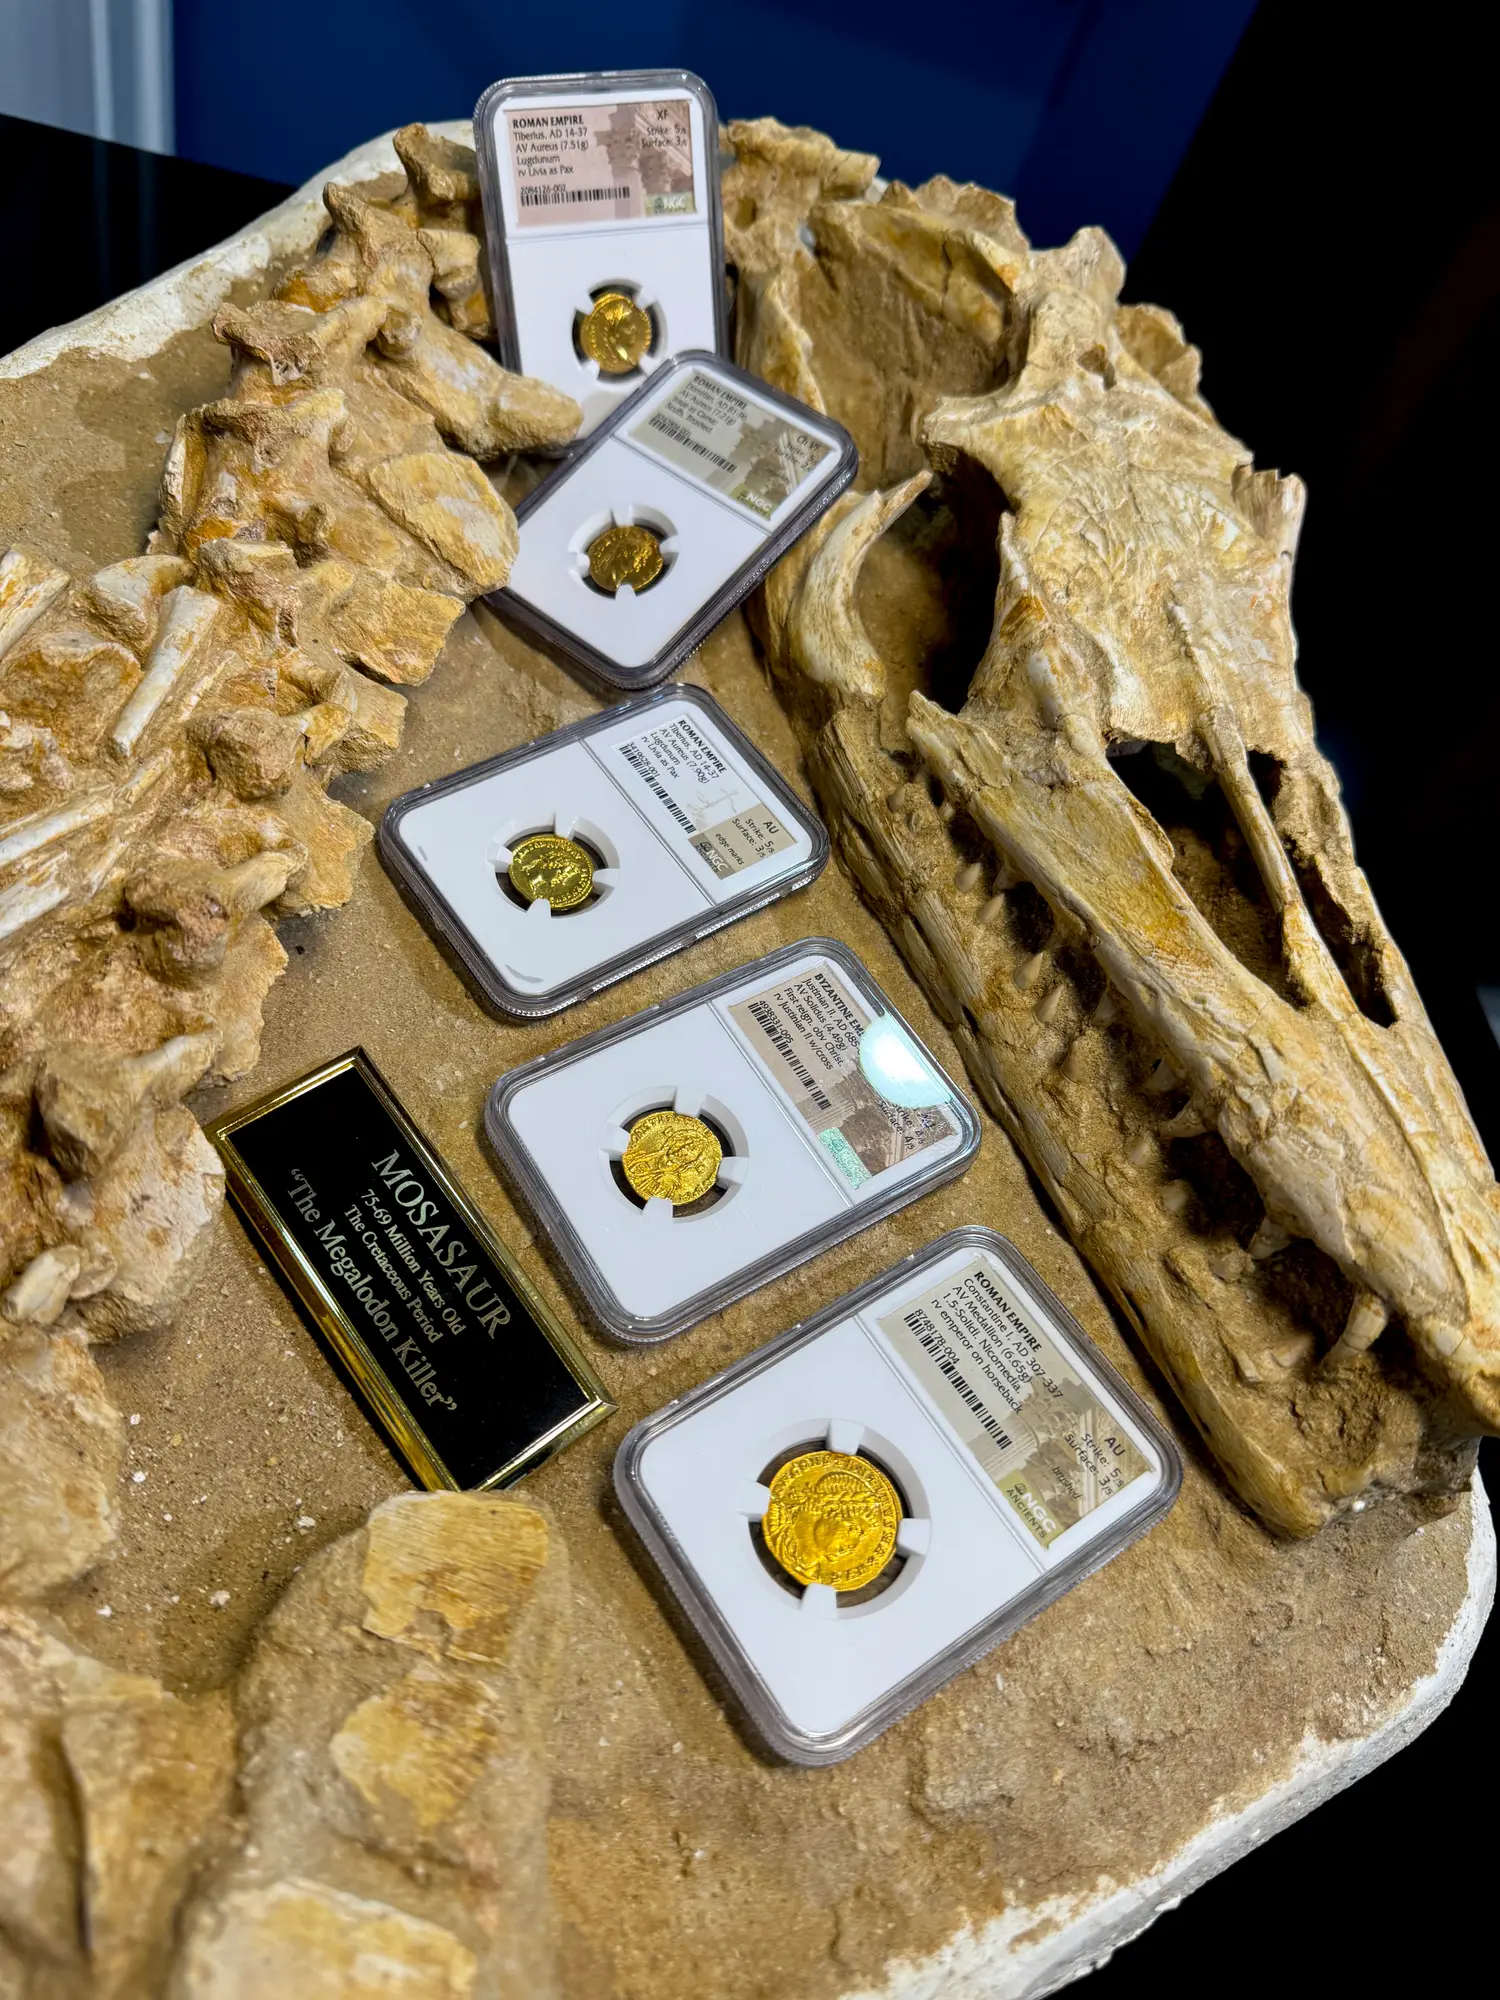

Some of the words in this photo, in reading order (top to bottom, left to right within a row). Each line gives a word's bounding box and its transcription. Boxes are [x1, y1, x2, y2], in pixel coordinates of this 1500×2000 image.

[512, 117, 550, 129] ROMAN
[550, 114, 584, 126] EMPIRE
[513, 130, 545, 141] Tiberius,
[548, 129, 562, 138] AD
[564, 127, 588, 137] 14-37
[656, 110, 668, 120] XF
[514, 144, 528, 153] AV
[529, 142, 558, 152] Aureus
[559, 139, 589, 152] (7.51g)
[516, 153, 560, 168] Lugdunum
[518, 169, 527, 177] rv
[559, 164, 573, 173] Pax
[692, 375, 721, 394] ROMAN
[720, 391, 748, 409] EMPIRE
[627, 742, 660, 778] 3419628-001
[648, 744, 662, 759] Livia
[667, 766, 679, 778] Pax
[651, 732, 680, 765] Lugdunum
[660, 729, 672, 737] AV
[669, 740, 688, 760] Aureus
[687, 761, 709, 783] (7.90g)
[669, 724, 691, 749] Tiberius,
[690, 750, 702, 760] AD
[700, 761, 719, 778] 14-37
[678, 720, 704, 747] ROMAN
[701, 747, 726, 773] EMPIRE
[716, 834, 729, 847] edge
[728, 848, 744, 865] marks
[732, 819, 756, 845] Surface:
[755, 846, 765, 858] 3/5
[745, 819, 765, 840] Strike:
[764, 841, 775, 853] 5/5
[763, 822, 779, 833] AU
[706, 850, 728, 871] NGC
[794, 984, 808, 994] AV
[804, 996, 826, 1023] Solidus
[823, 1024, 848, 1051] (4.49g)
[801, 978, 829, 1009] Justinian
[833, 1019, 847, 1030] AD
[814, 973, 853, 1020] BYZANTINE
[757, 1001, 793, 1044] 4938331-095
[778, 1001, 805, 1033] Justinian
[809, 1040, 833, 1070] w/cross
[784, 987, 799, 1004] First
[796, 1004, 813, 1026] reign.
[813, 1027, 826, 1040] obv
[825, 1042, 844, 1067] Christ.
[876, 1101, 906, 1134] Surface:
[903, 1136, 915, 1149] 4/5
[361, 1189, 392, 1224] 75-69
[384, 1224, 420, 1273] Million
[418, 1270, 445, 1308] Years
[442, 1308, 466, 1335] Old
[372, 1149, 510, 1339] MOSASAUR
[314, 1220, 398, 1342] Megalodon
[345, 1204, 365, 1231] The
[362, 1232, 411, 1300] Cretaceous
[407, 1297, 443, 1343] Period
[953, 1287, 969, 1299] AV
[968, 1306, 1003, 1347] Medallion
[1001, 1348, 1034, 1383] (6.65g)
[974, 1271, 1011, 1313] ROMAN
[1006, 1312, 1041, 1352] EMPIRE
[915, 1309, 960, 1364] 8748178-004
[931, 1300, 942, 1308] rv
[941, 1311, 973, 1349] emperor
[972, 1352, 983, 1365] on
[982, 1364, 1024, 1414] horseback
[943, 1293, 980, 1339] 1.5-Solidi.
[979, 1339, 1020, 1393] Nicomedia.
[964, 1279, 1007, 1332] Constantine
[1012, 1342, 1028, 1356] AD
[1026, 1358, 1064, 1399] 307-337
[1063, 1434, 1099, 1476] Surface:
[1096, 1476, 1113, 1495] 3/5
[1081, 1433, 1109, 1467] Strike:
[1110, 1468, 1124, 1487] 5/5
[1104, 1438, 1125, 1456] AU
[1052, 1466, 1081, 1500] brushed
[1006, 1489, 1047, 1538] ANCIENTS
[1022, 1492, 1056, 1532] NGC
